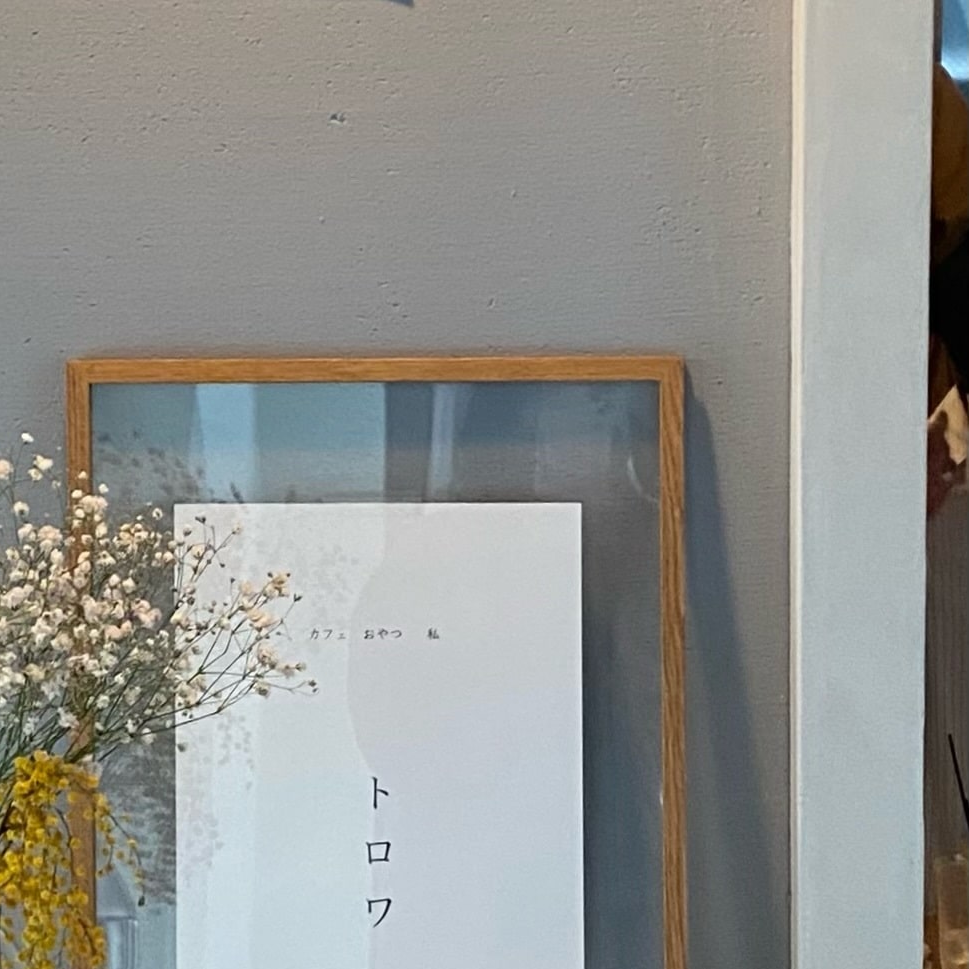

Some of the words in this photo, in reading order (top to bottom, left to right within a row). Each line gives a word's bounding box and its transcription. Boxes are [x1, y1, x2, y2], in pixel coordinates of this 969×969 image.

[310, 628, 347, 640] カフェ
[364, 628, 402, 640] おやつ
[366, 776, 392, 928] トロワ
